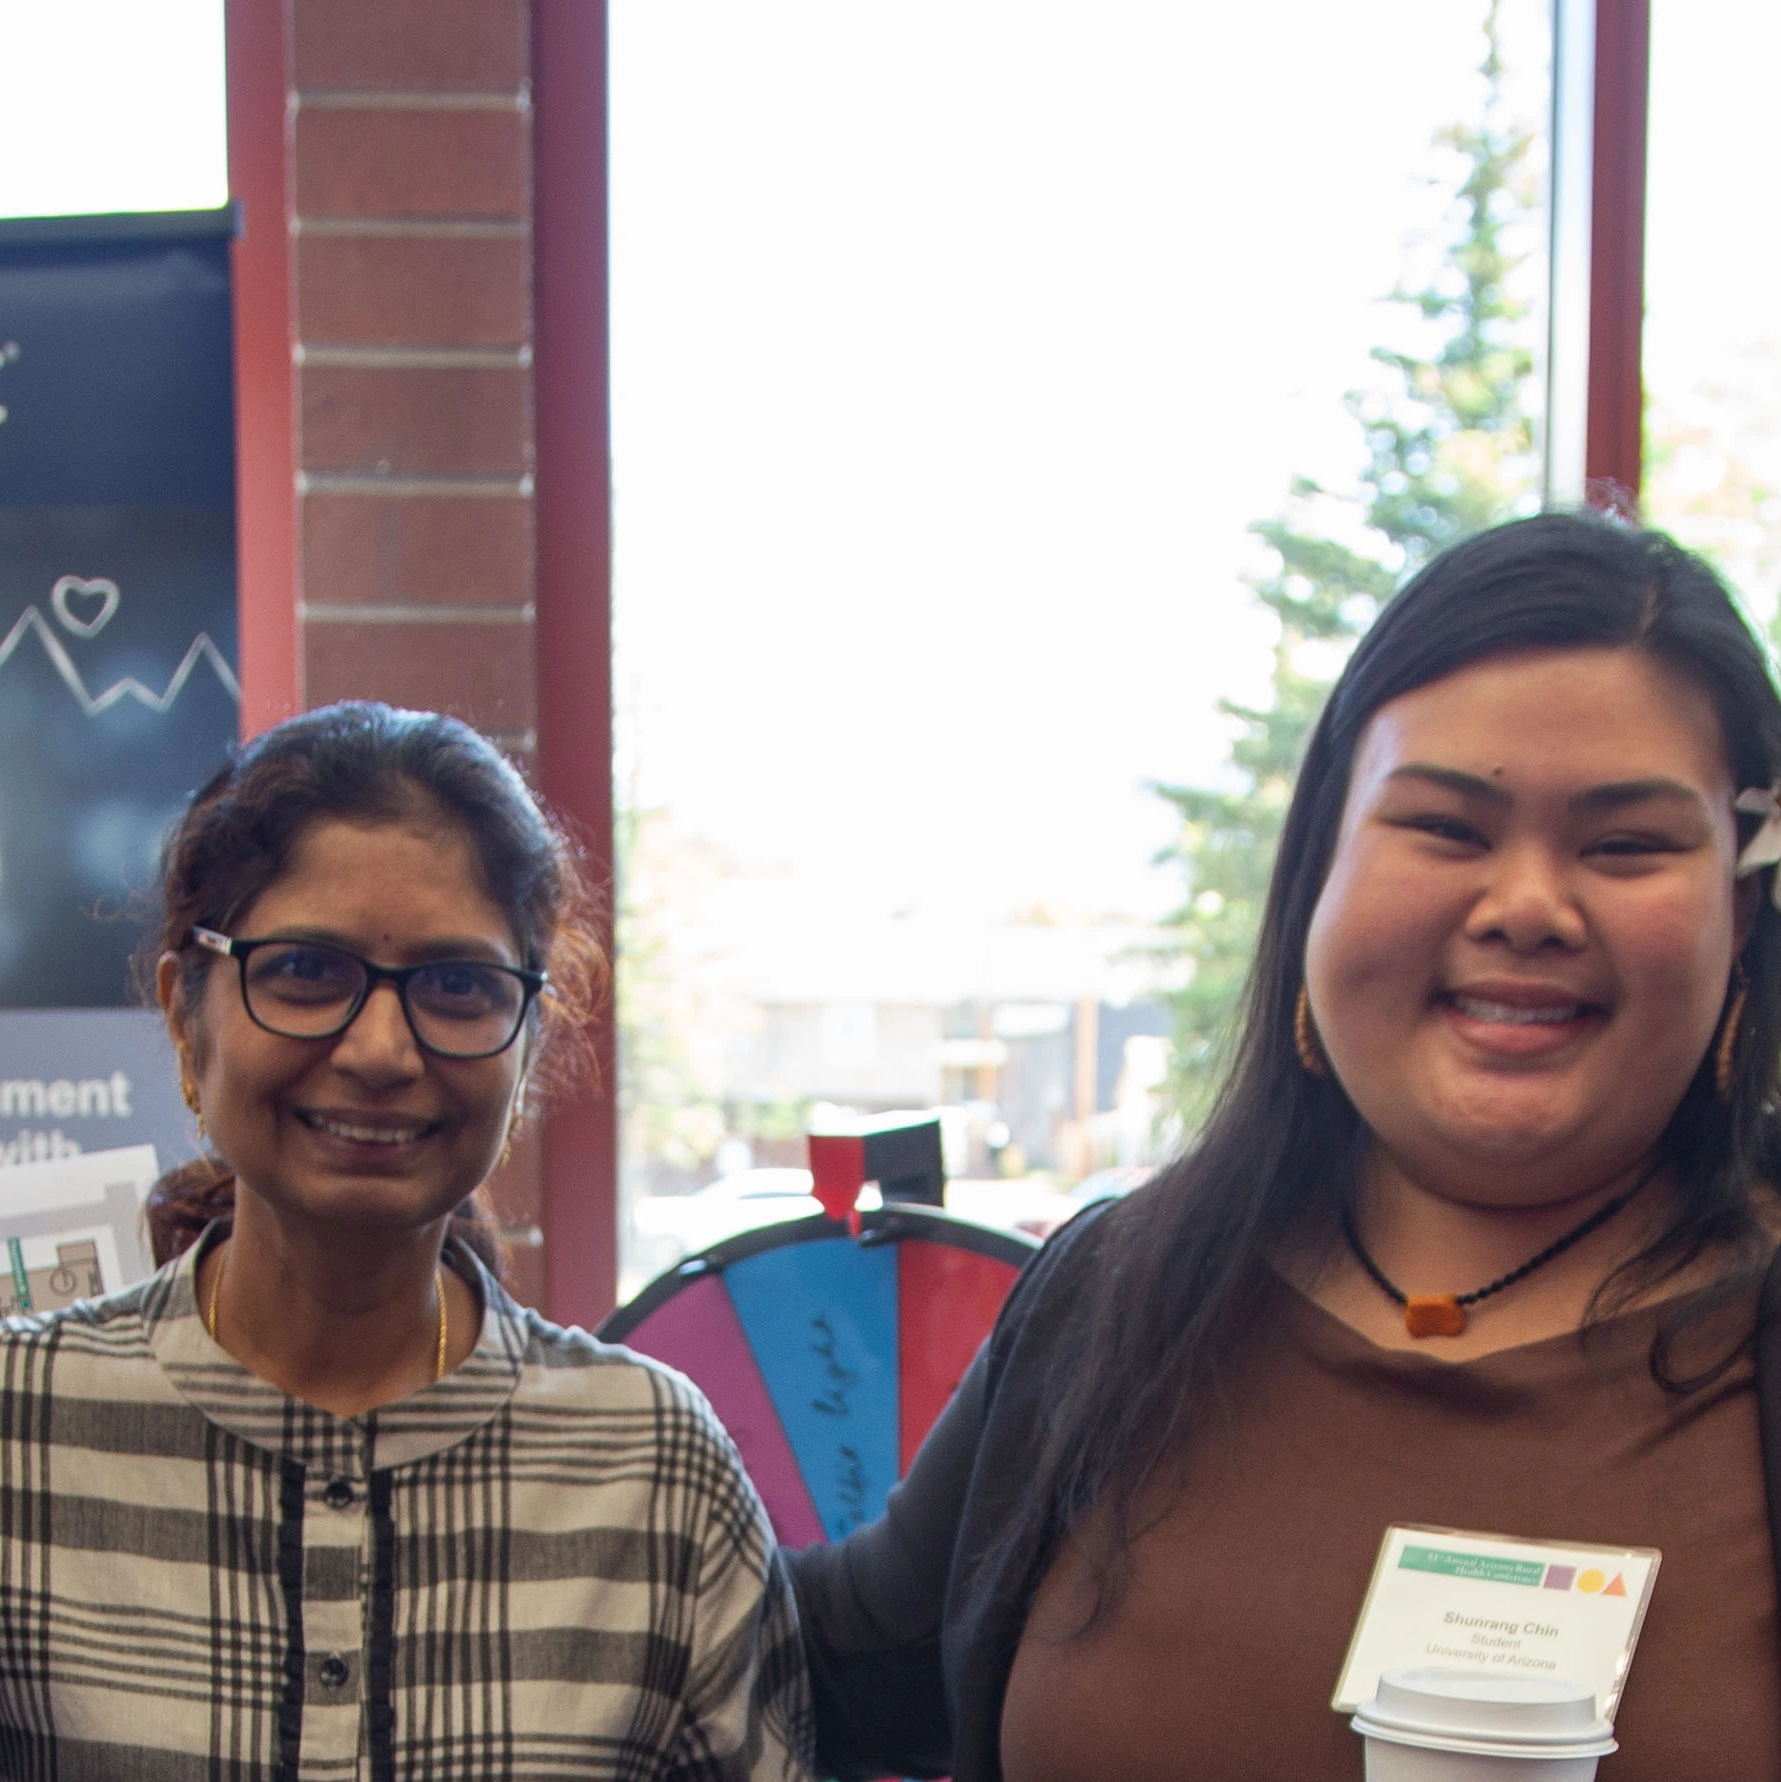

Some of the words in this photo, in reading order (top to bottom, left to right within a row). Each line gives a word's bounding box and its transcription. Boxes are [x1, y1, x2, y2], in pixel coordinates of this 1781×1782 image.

[1523, 1621, 1560, 1638] Chin
[1470, 1632, 1522, 1649] Student
[1425, 1642, 1490, 1664] University
[1492, 1651, 1507, 1664] of
[1508, 1654, 1557, 1672] Arizona
